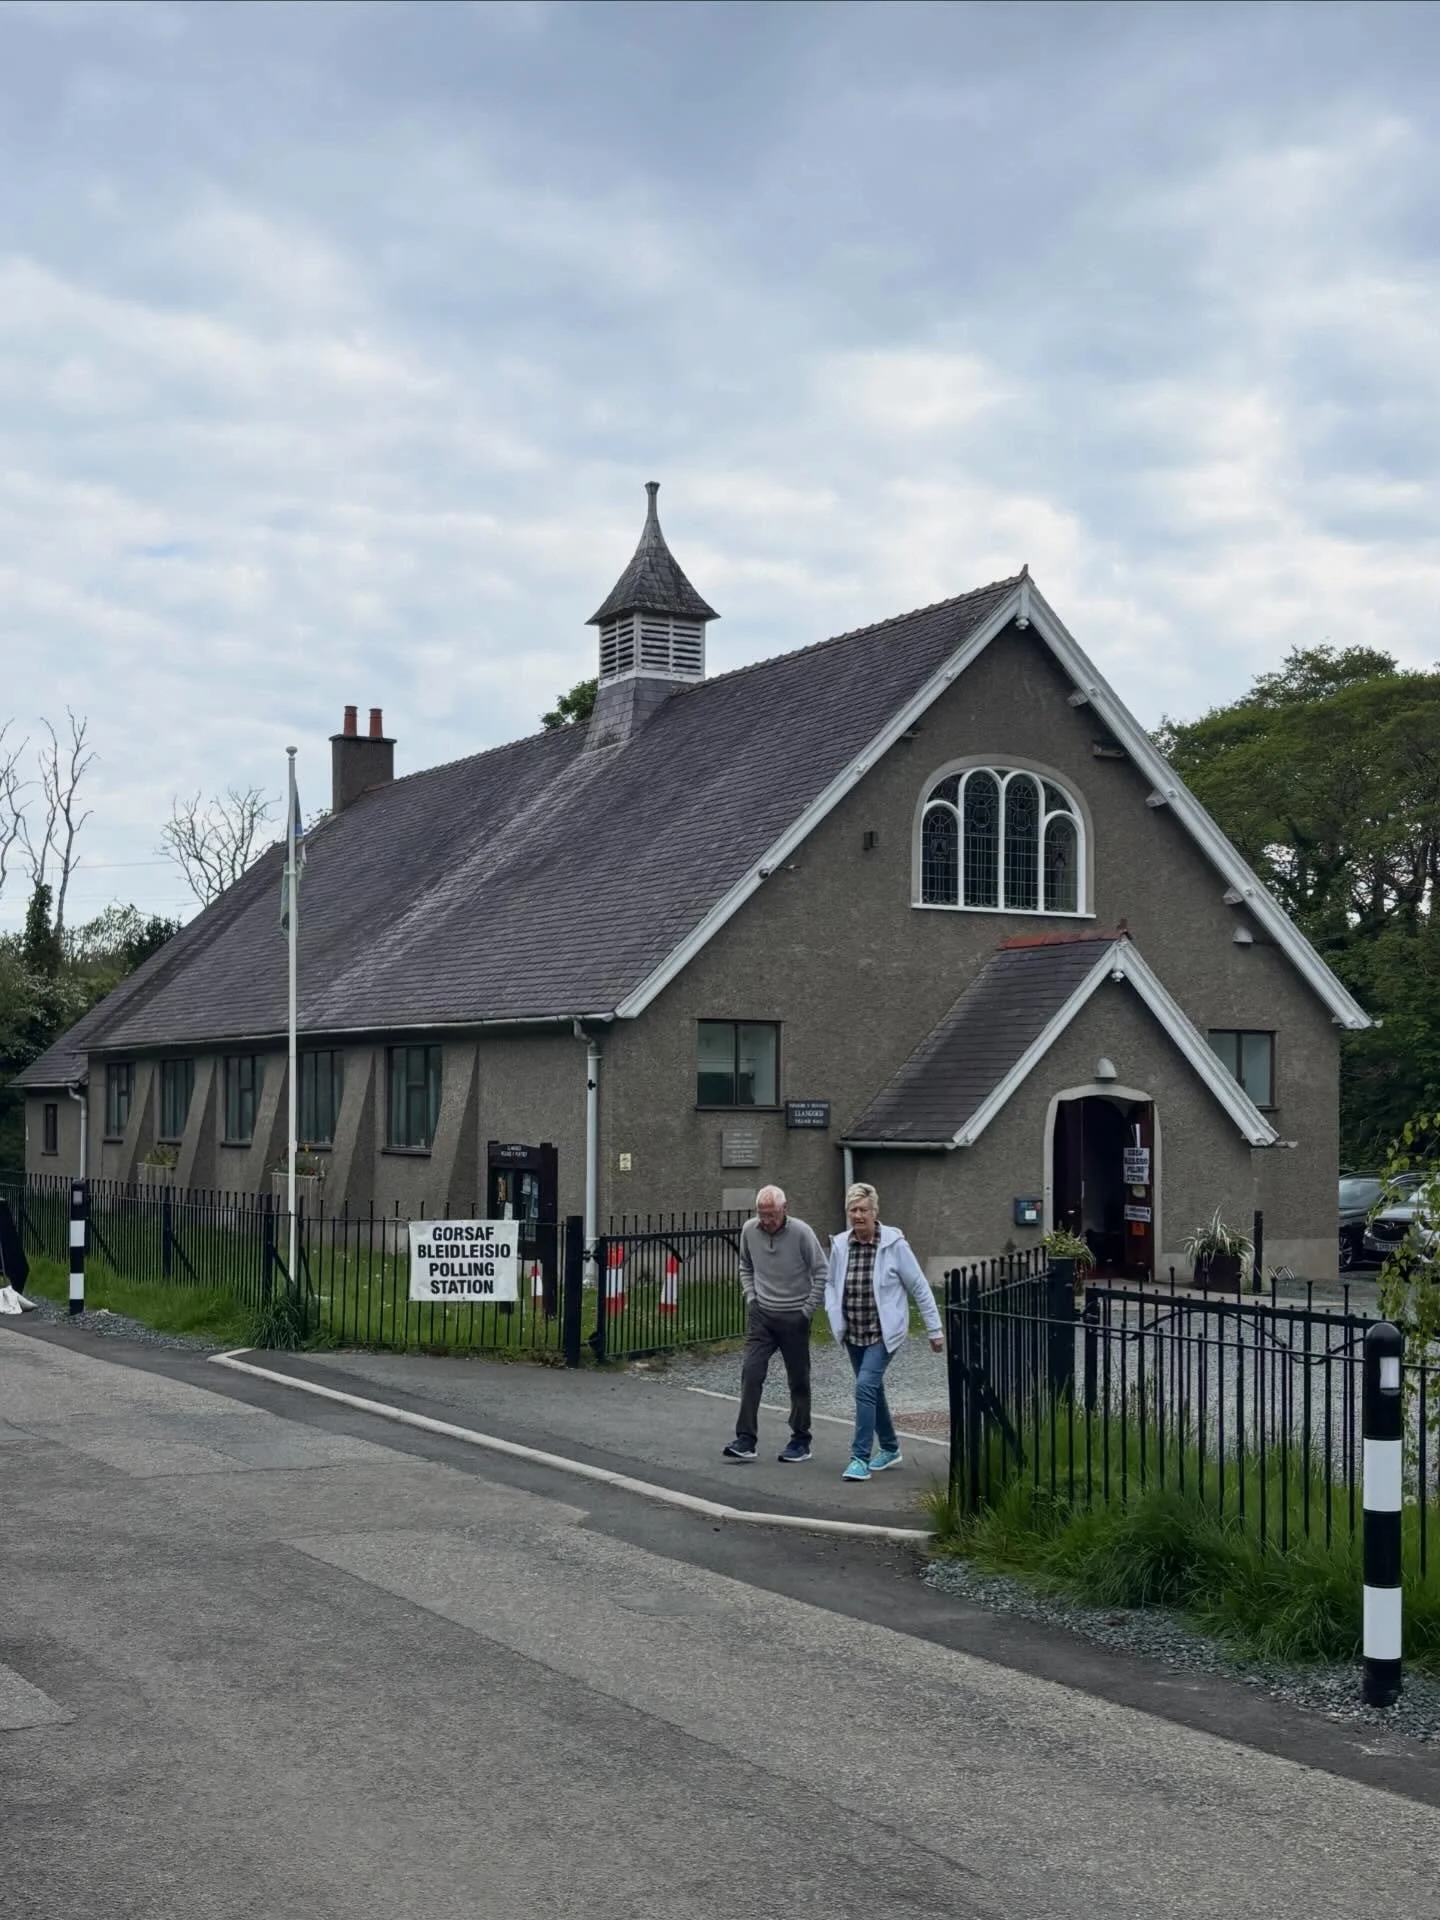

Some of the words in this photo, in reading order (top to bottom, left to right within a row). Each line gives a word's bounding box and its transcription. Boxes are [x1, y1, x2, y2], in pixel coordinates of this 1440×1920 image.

[432, 1226, 494, 1241] GORSAF
[417, 1243, 511, 1259] BLEIDLEISIO
[429, 1262, 494, 1277] POLLING
[430, 1279, 494, 1294] STATION
